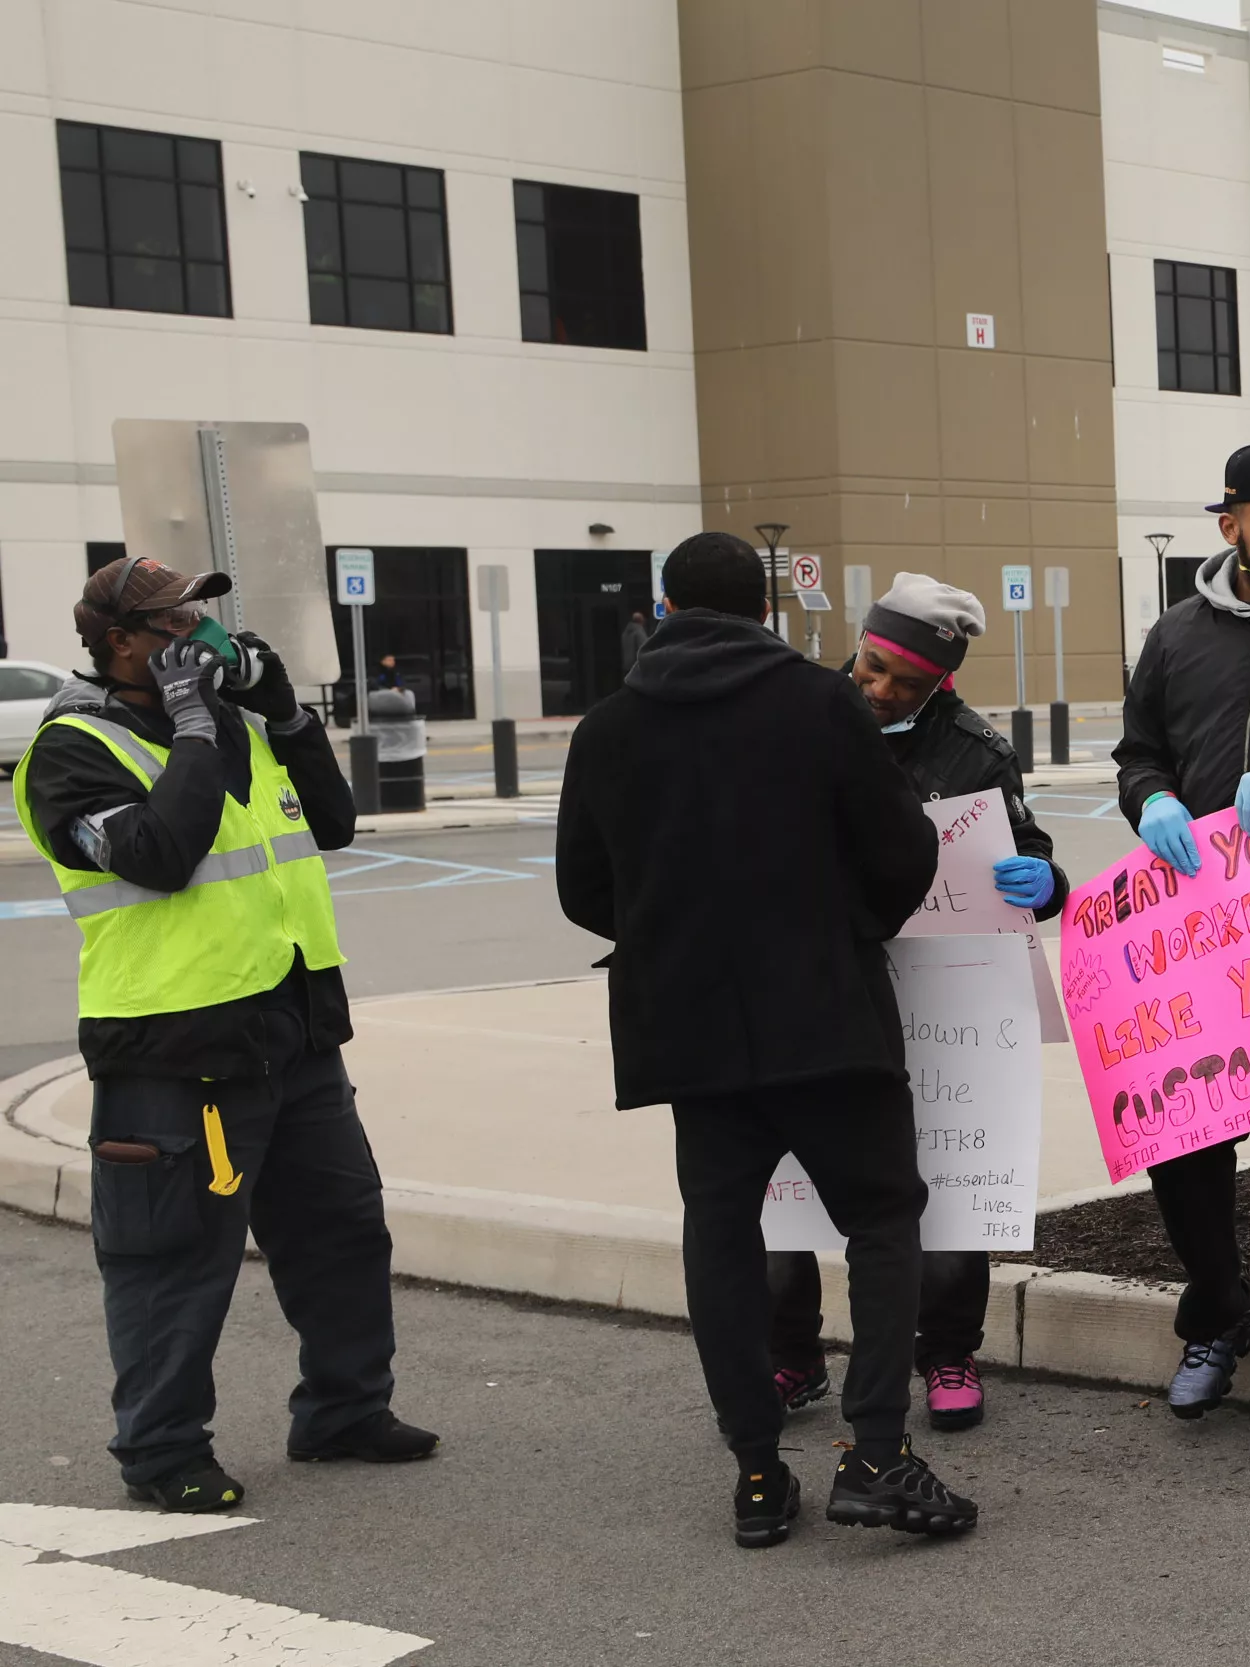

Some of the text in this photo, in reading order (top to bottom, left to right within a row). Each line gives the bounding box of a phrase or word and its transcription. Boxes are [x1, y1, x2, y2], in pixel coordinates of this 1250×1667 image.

[976, 327, 985, 344] H
[941, 798, 989, 846] #JFK8
[1073, 857, 1179, 938] TREAT
[996, 1018, 1018, 1049] &
[1093, 992, 1203, 1070] LIKE
[917, 1068, 973, 1103] the
[1112, 1142, 1160, 1178] #STOP
[1175, 1124, 1215, 1150] THE
[982, 1222, 1021, 1238] JFK8
